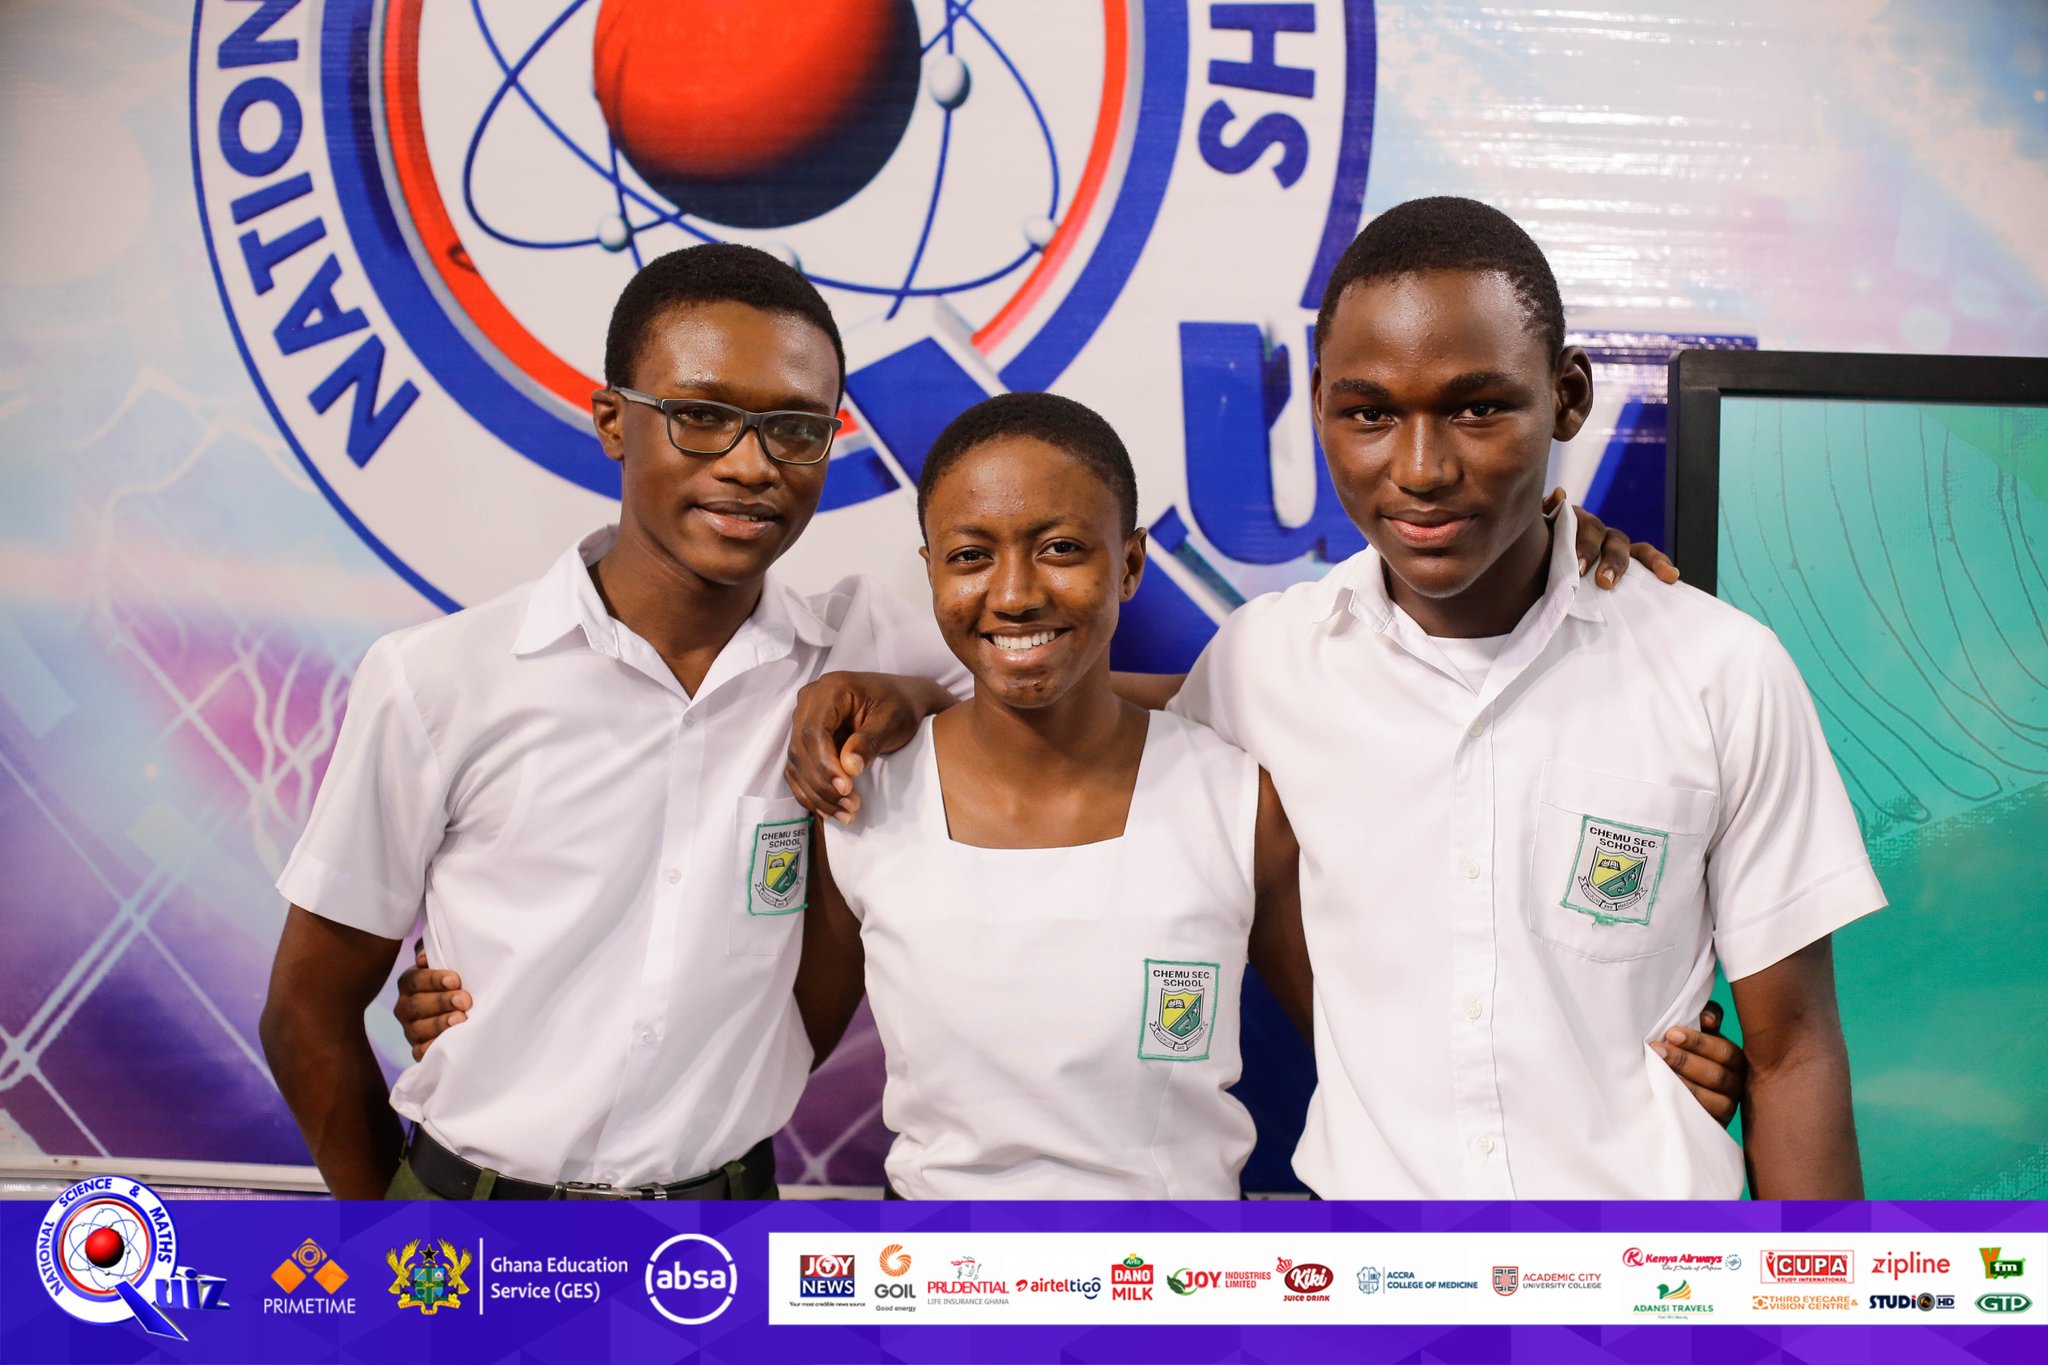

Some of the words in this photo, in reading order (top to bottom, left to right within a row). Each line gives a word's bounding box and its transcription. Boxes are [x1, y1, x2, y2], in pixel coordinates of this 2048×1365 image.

[761, 830, 792, 841] CHEMU
[1590, 826, 1631, 843] CHEMU
[1634, 837, 1658, 849] SEC.
[769, 838, 802, 849] SCHOOL
[1600, 838, 1647, 855] SCHOOL
[1153, 969, 1190, 979] CHEMU
[1192, 971, 1212, 980] SEC.
[1163, 979, 1204, 988] SCHOOL
